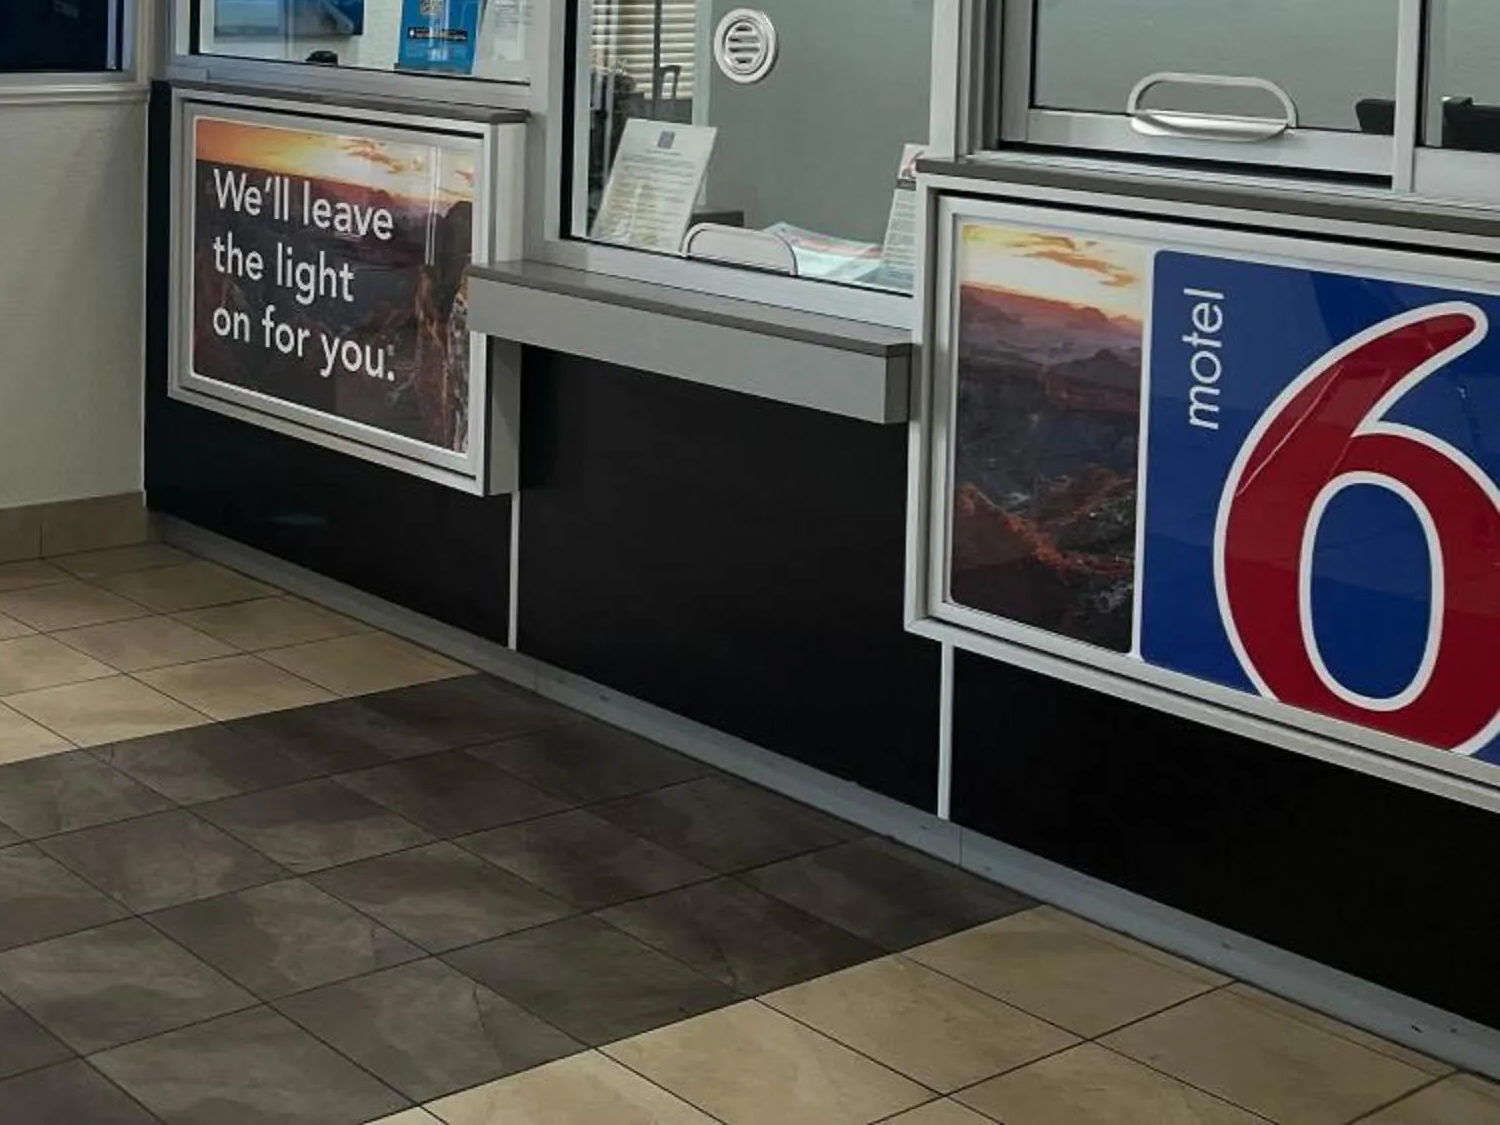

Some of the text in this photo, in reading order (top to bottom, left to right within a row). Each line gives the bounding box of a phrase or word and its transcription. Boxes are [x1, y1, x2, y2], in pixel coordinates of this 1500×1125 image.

[213, 168, 394, 241] We'll leave
[213, 230, 355, 306] the light
[213, 307, 250, 343] on
[262, 304, 310, 358] for
[1182, 287, 1225, 430] motel
[1213, 300, 1500, 757] 6
